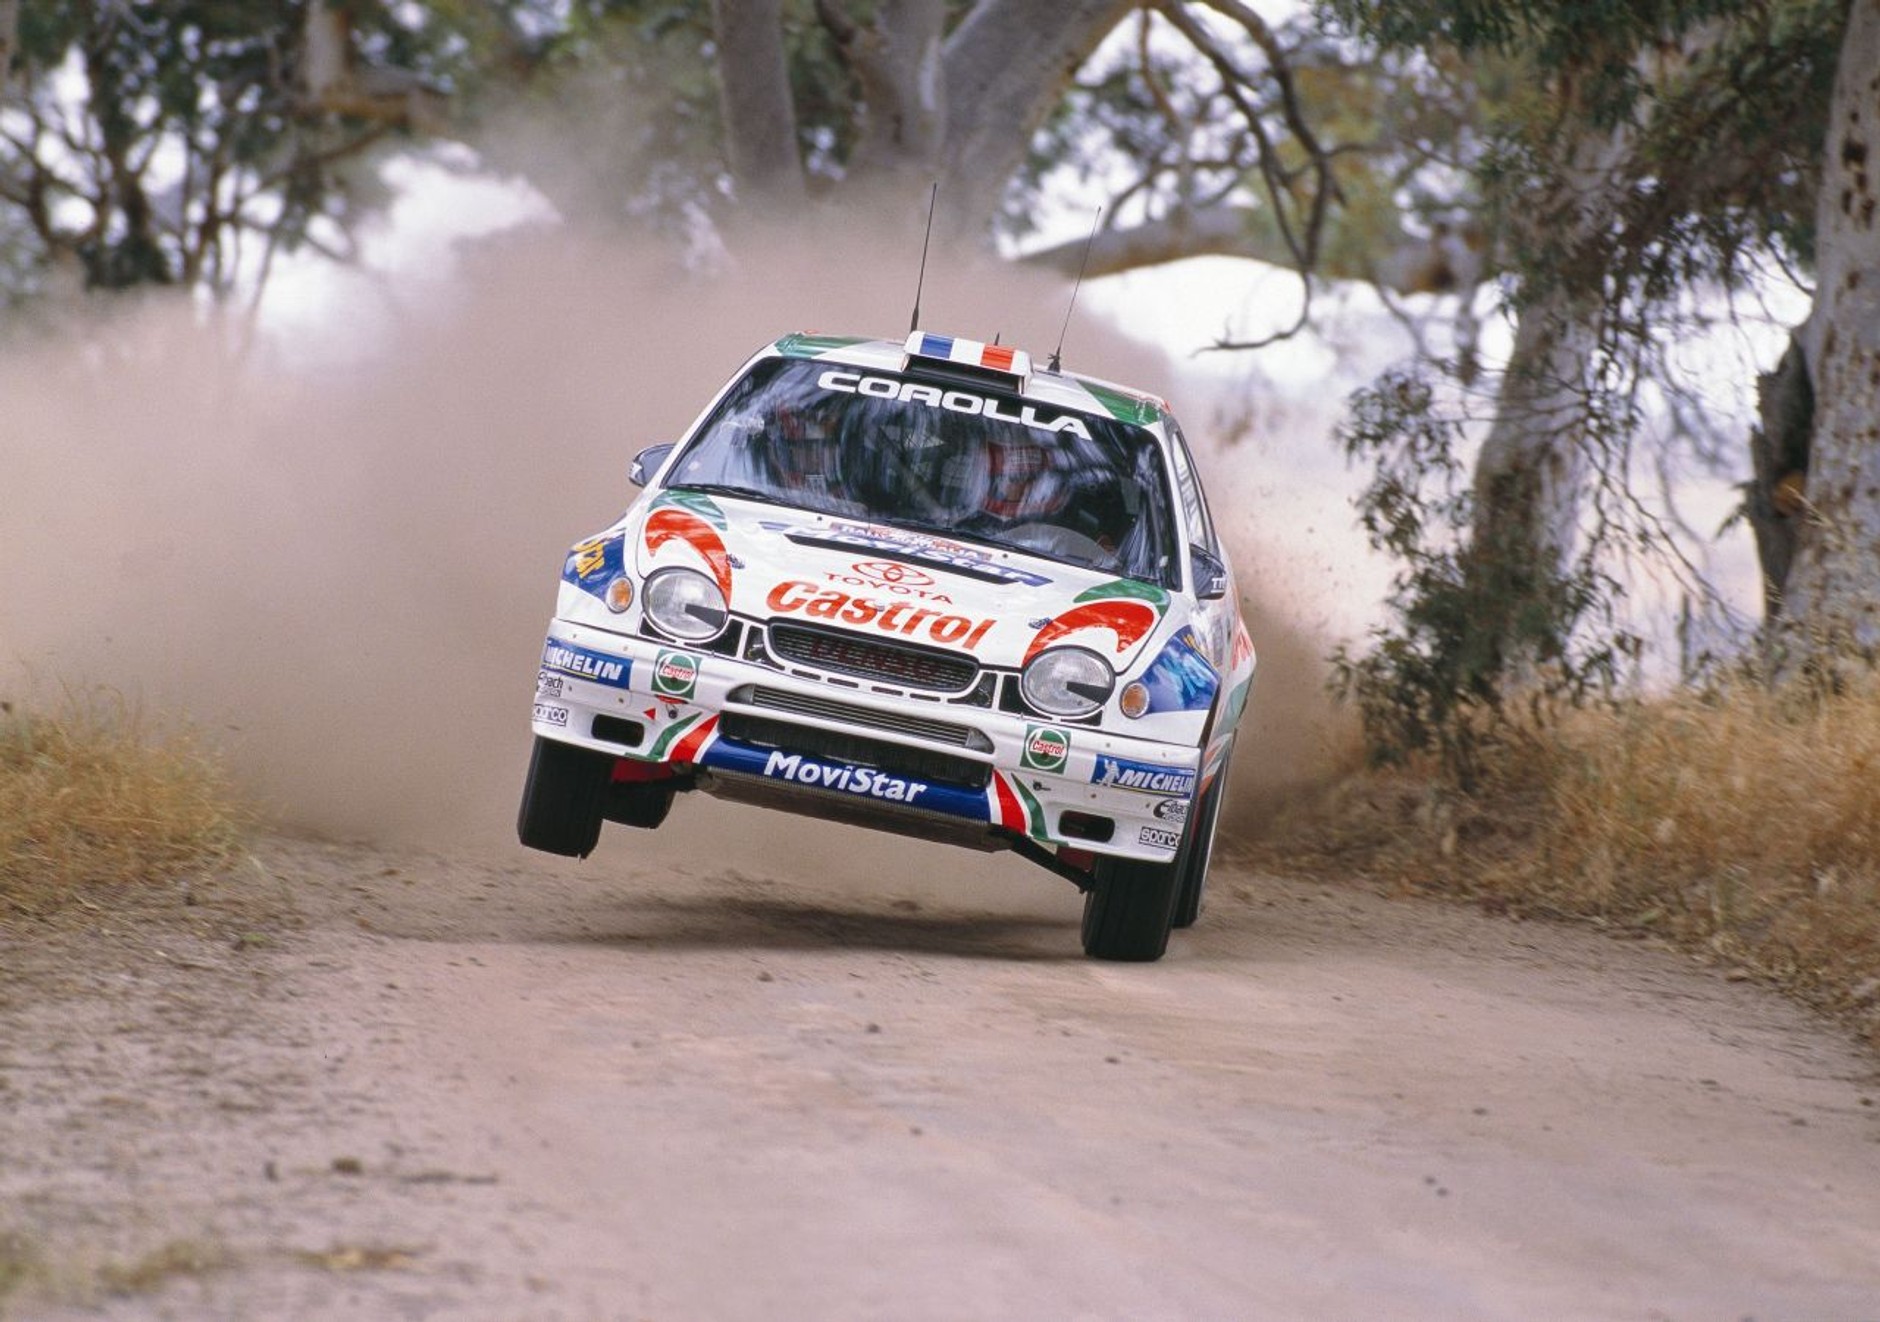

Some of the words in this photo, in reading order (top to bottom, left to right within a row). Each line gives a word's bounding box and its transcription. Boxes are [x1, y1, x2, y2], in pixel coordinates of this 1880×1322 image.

[817, 371, 1093, 440] COROLLA
[822, 571, 954, 604] TOYOTA
[766, 580, 997, 650] Castrol
[662, 665, 694, 680] Castrol
[535, 705, 567, 722] parco
[1032, 740, 1065, 755] Castrol
[764, 751, 927, 802] MoviStar
